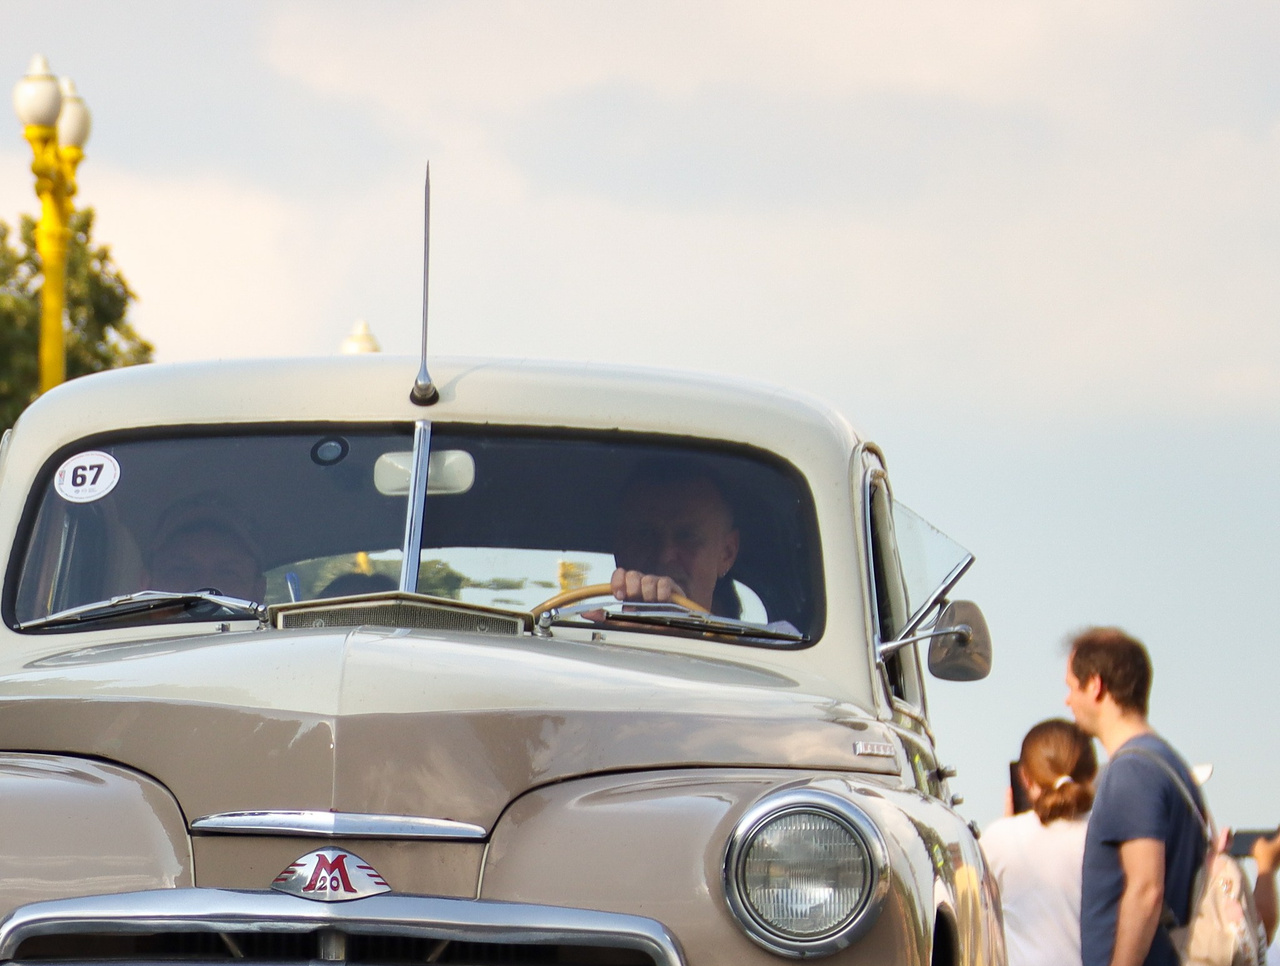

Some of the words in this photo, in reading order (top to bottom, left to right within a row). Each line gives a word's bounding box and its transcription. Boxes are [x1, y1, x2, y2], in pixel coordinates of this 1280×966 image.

[71, 463, 105, 488] 67
[302, 853, 358, 893] М
[317, 875, 341, 892] 20
